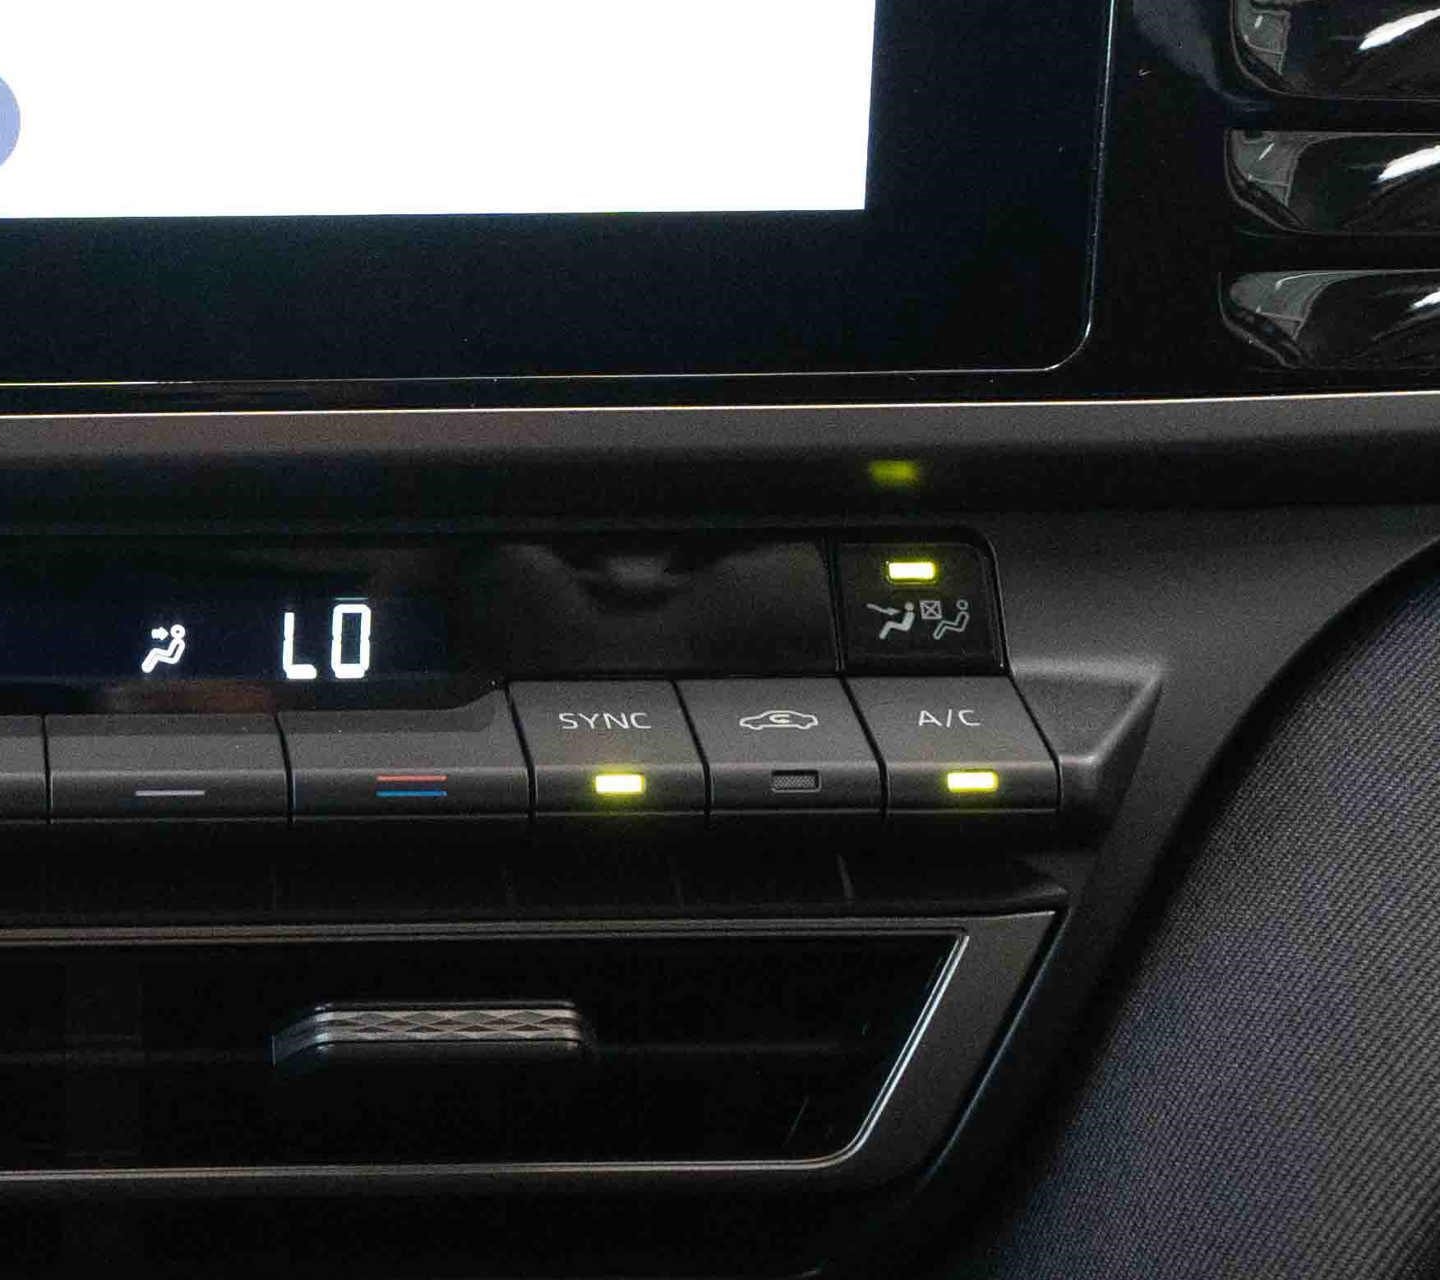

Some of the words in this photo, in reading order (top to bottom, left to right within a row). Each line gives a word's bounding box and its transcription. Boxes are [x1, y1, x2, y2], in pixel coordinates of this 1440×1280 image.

[282, 601, 373, 681] LO
[557, 710, 653, 731] SYNC
[917, 707, 982, 728] A/C
